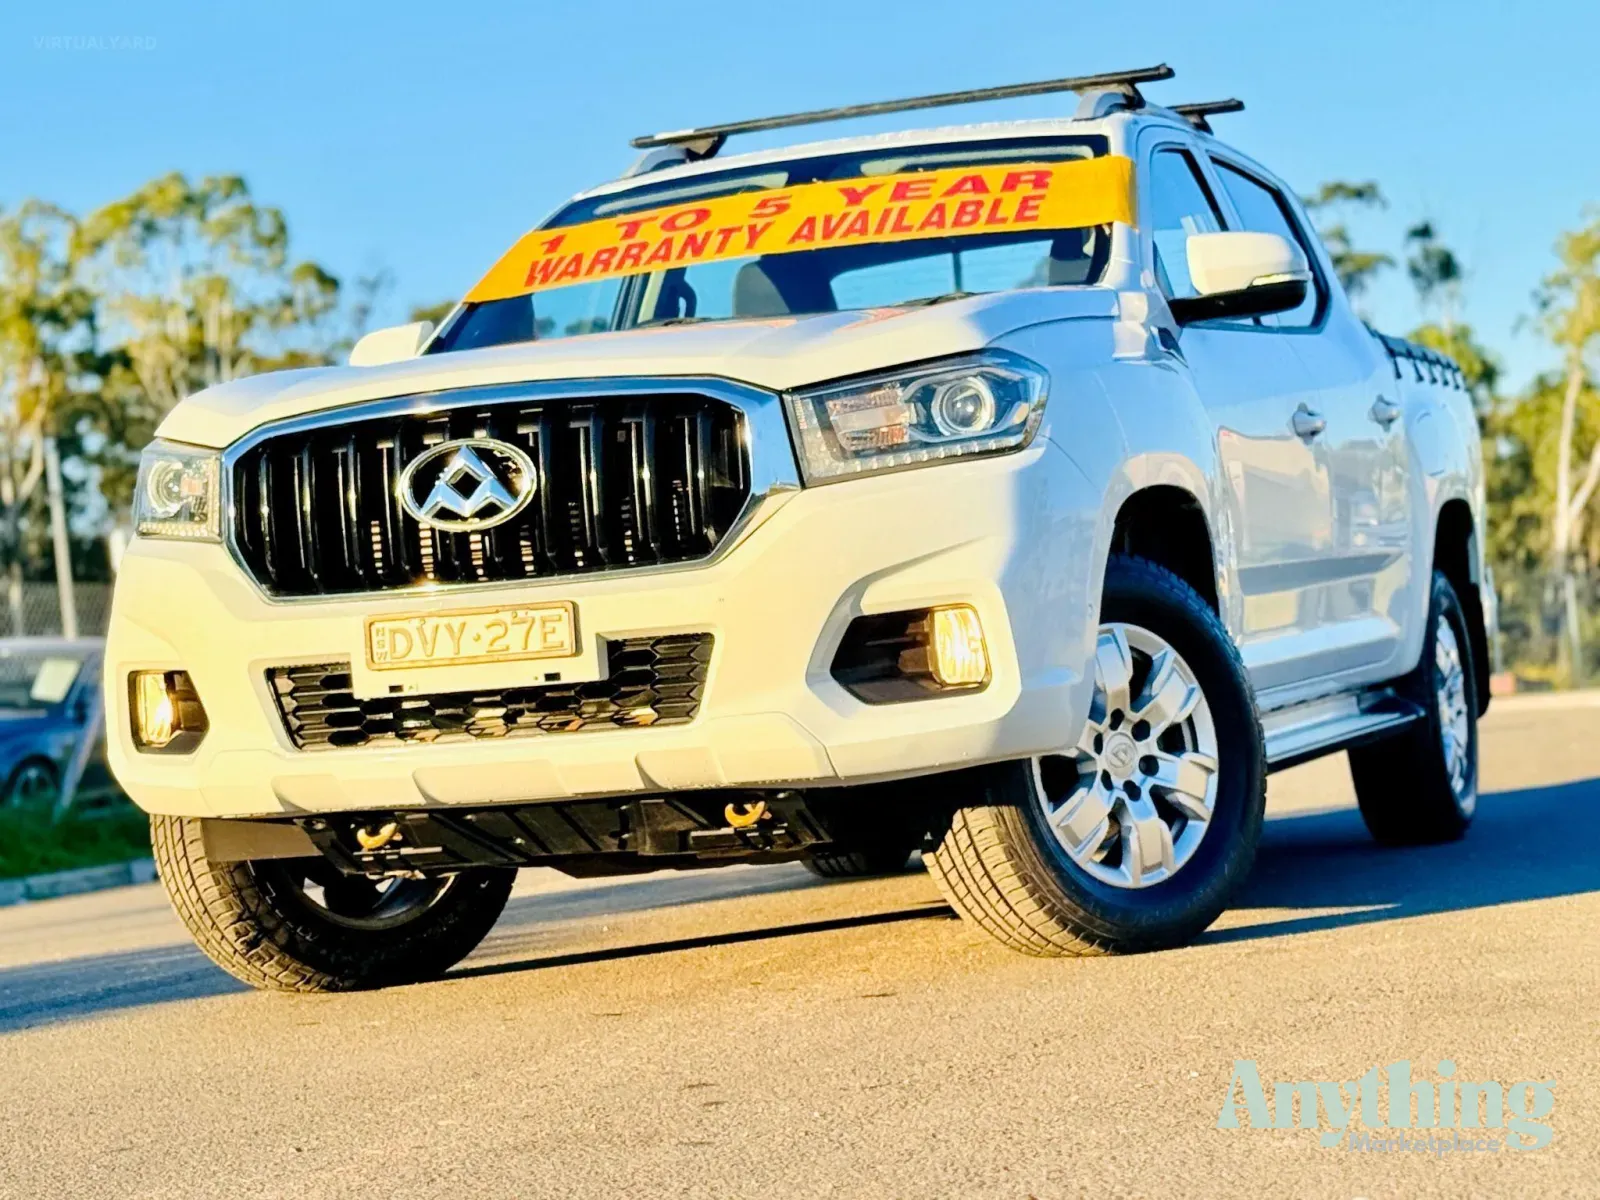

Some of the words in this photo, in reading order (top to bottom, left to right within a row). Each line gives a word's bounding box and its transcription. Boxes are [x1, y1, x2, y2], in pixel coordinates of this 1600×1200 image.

[523, 221, 775, 288] WARRANTY
[787, 194, 1047, 245] AVAILABLE
[540, 234, 567, 255] 1
[615, 208, 712, 241] TO
[748, 195, 792, 219] 5
[836, 170, 1054, 208] YEAR
